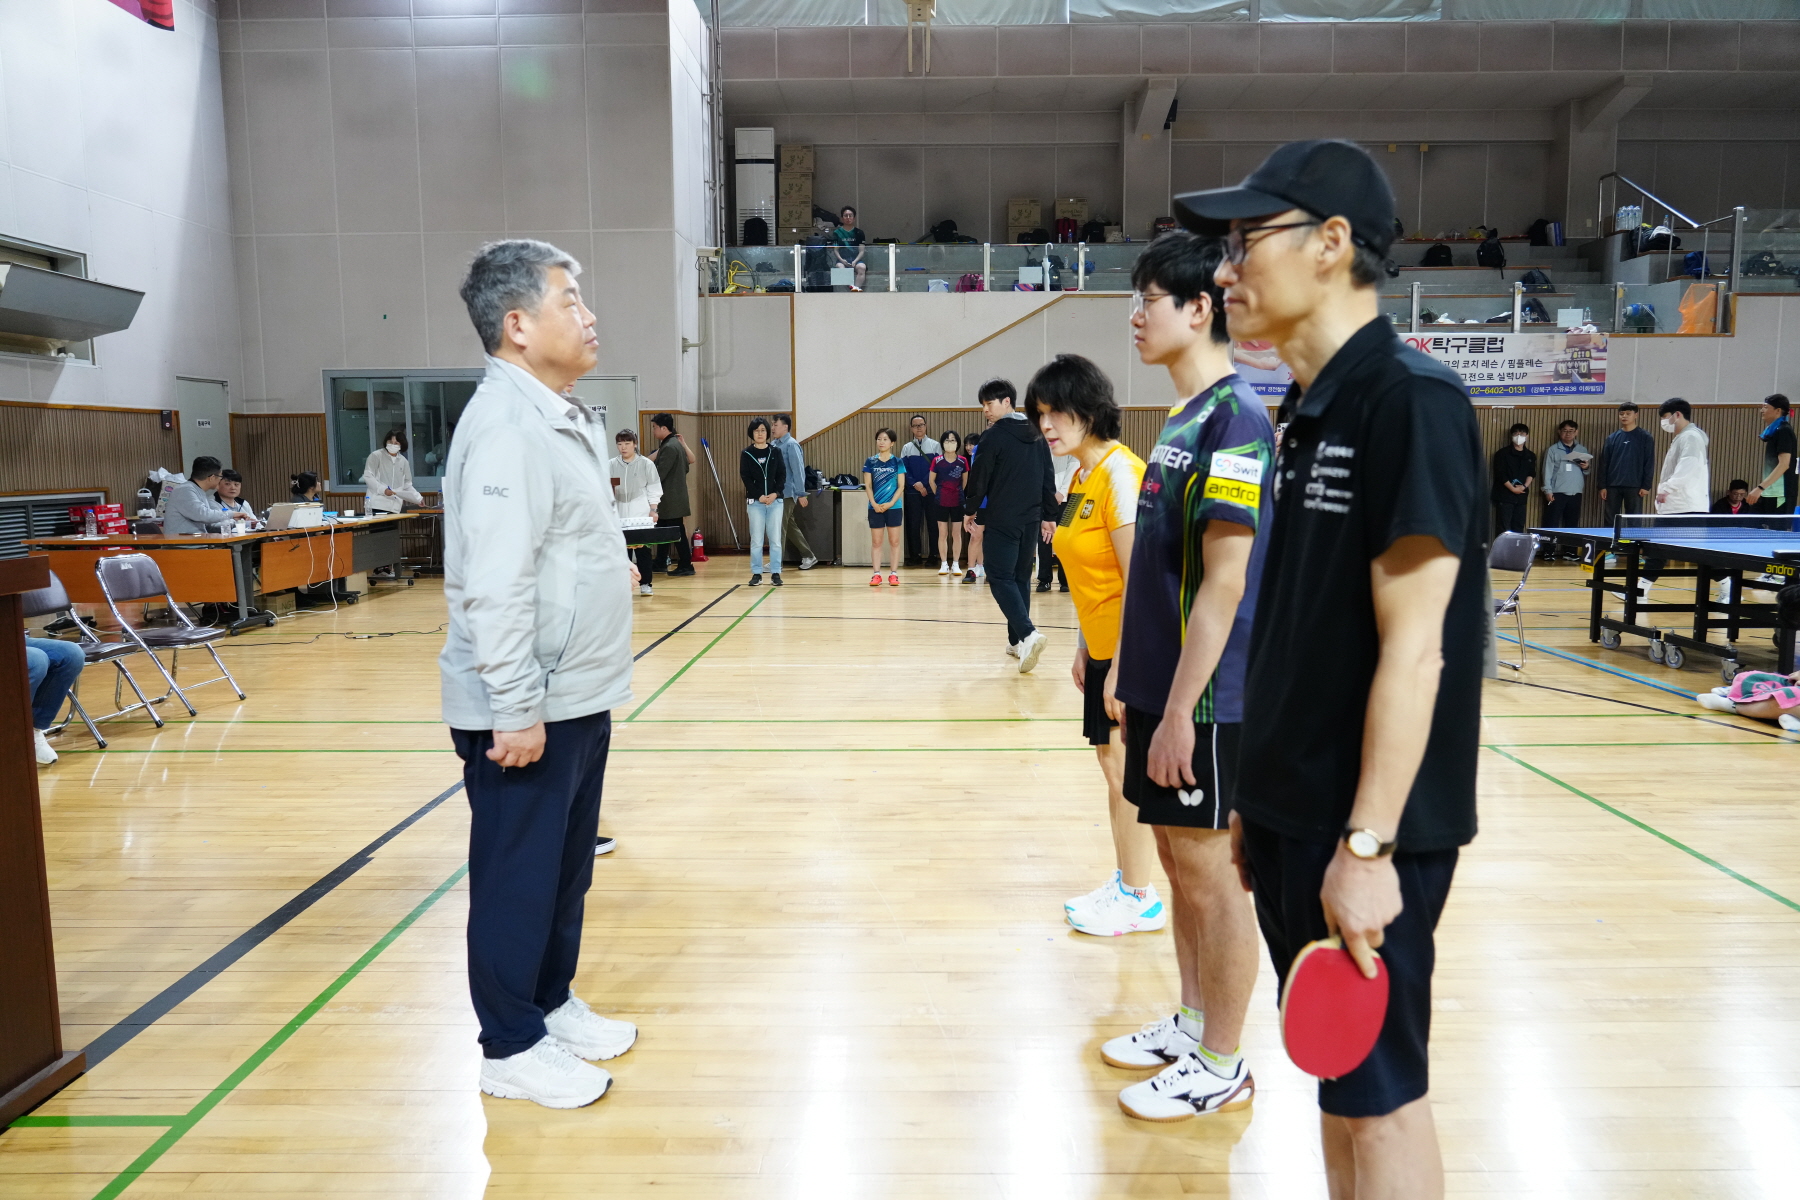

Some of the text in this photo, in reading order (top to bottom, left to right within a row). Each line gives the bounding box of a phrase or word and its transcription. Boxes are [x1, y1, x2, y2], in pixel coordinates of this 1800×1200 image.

[1462, 359, 1479, 369] 코치
[1481, 359, 1499, 369] 레슨
[1460, 372, 1495, 382] 그전으로
[1470, 386, 1526, 395] 02-6402-0131
[1232, 462, 1258, 478] Swit
[483, 485, 509, 498] BAC
[1208, 483, 1256, 502] andro
[1584, 542, 1592, 563] 2
[1765, 564, 1794, 576] andro
